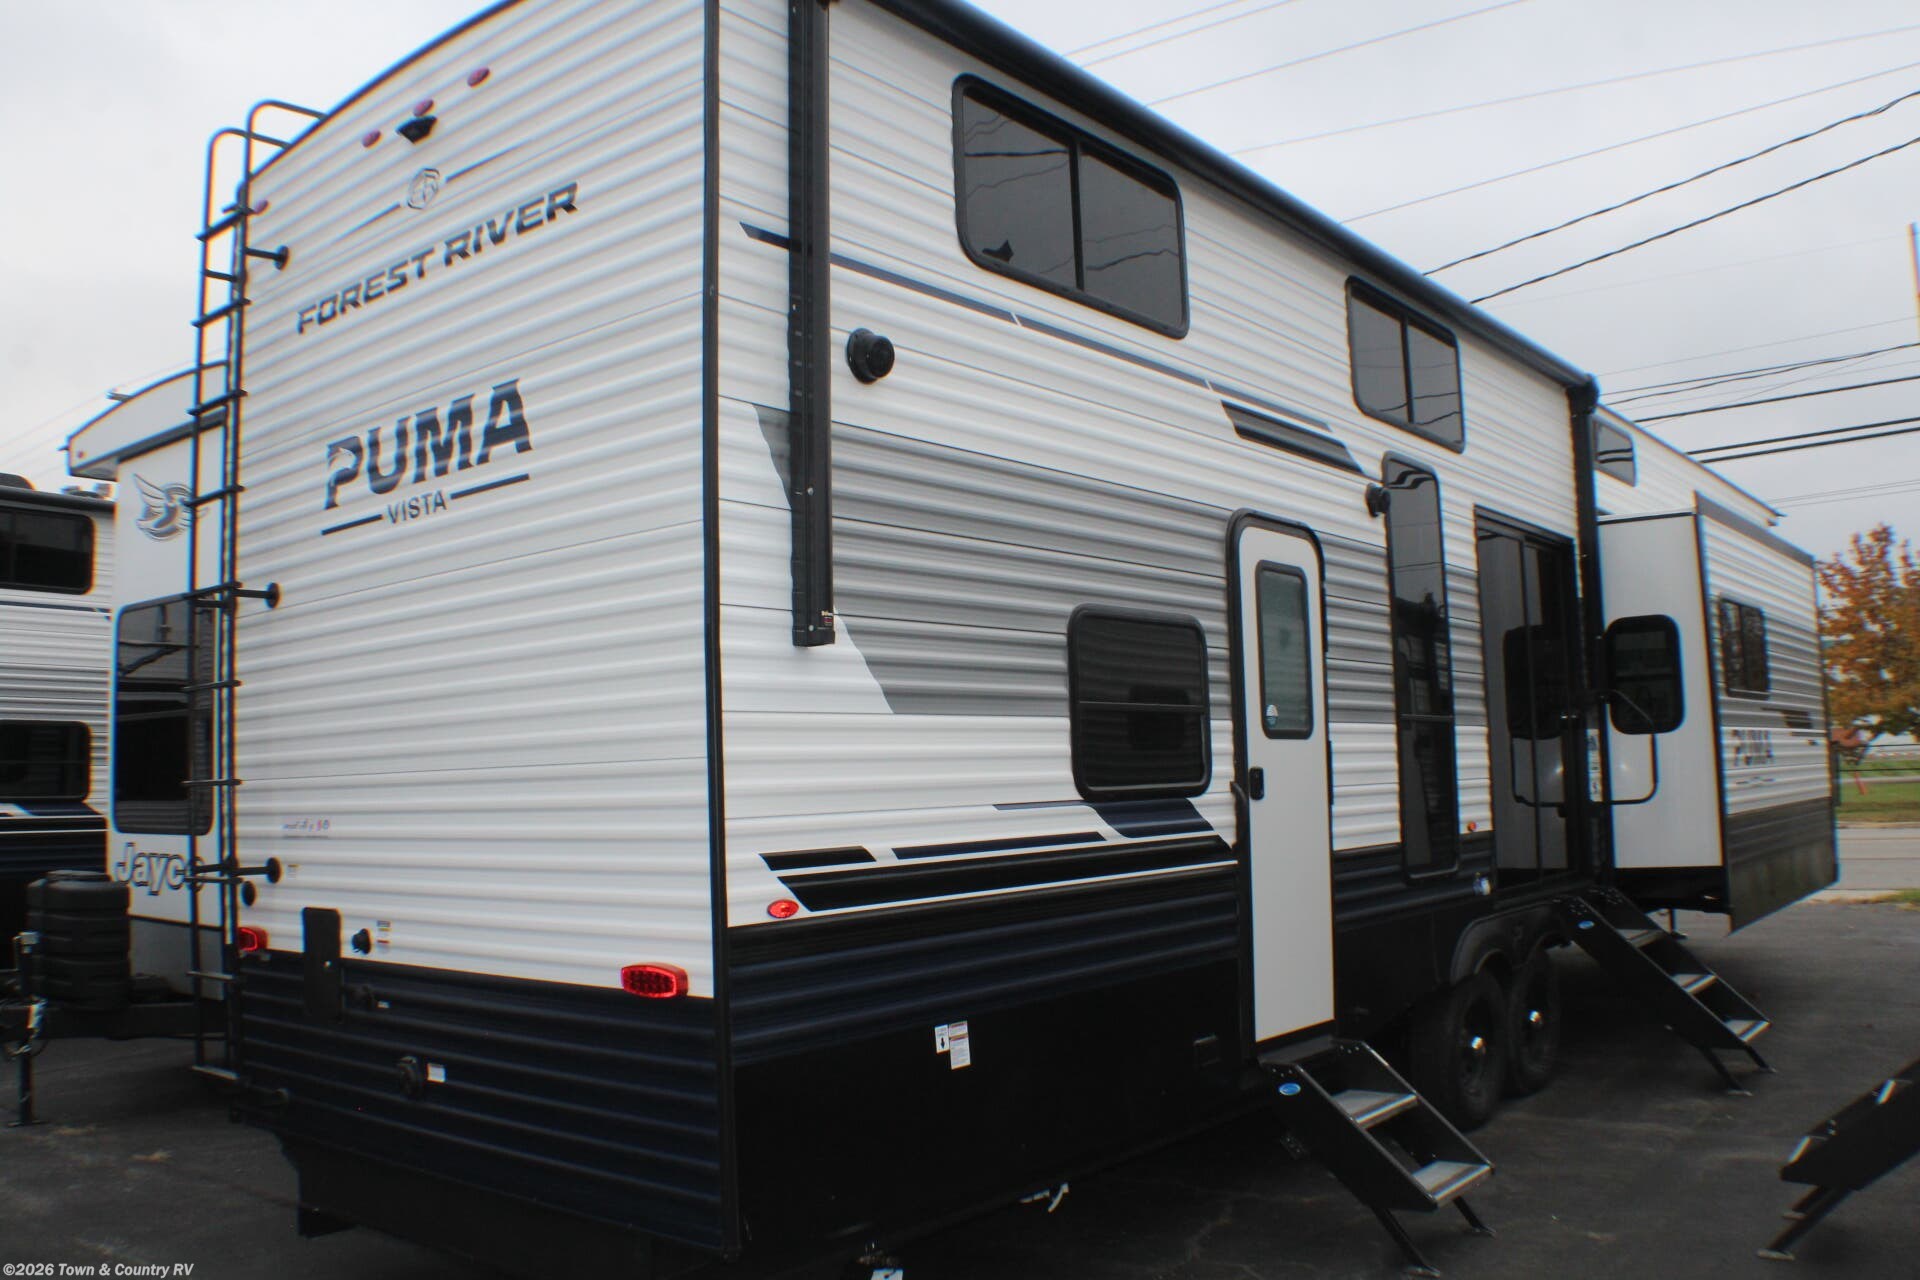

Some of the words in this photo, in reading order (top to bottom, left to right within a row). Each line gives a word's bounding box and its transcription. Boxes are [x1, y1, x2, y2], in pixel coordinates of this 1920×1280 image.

[296, 247, 436, 335] FOREST
[443, 181, 579, 267] RIVER
[324, 377, 532, 510] PUMA
[387, 490, 447, 524] VISTA
